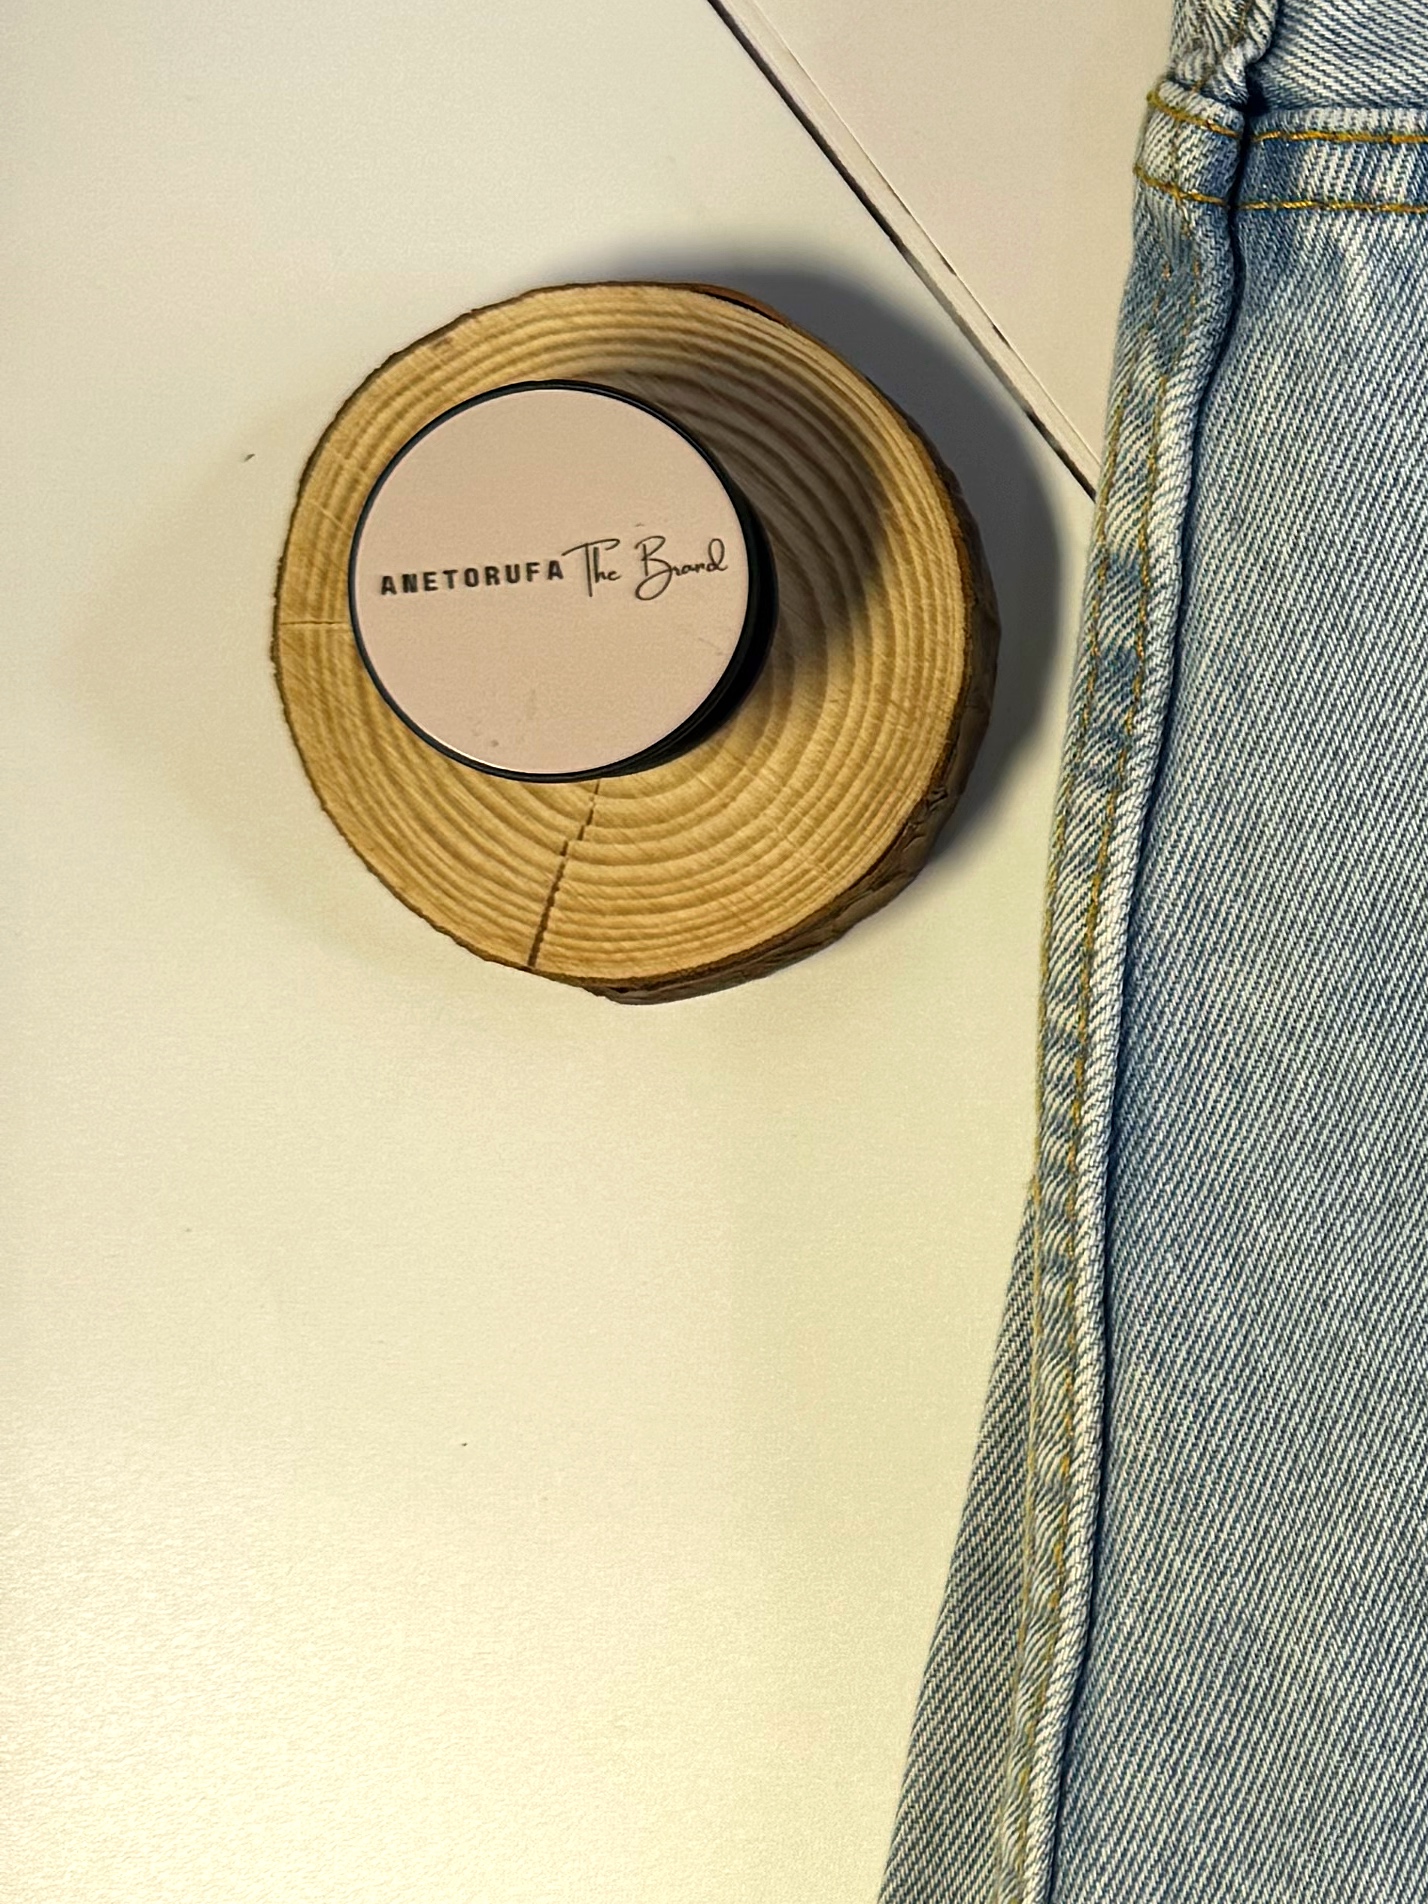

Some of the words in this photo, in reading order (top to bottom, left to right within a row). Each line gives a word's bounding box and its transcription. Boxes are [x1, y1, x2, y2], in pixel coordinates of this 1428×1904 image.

[379, 558, 564, 596] ANETORUFA
[560, 537, 622, 598] The
[632, 534, 729, 602] Brand
